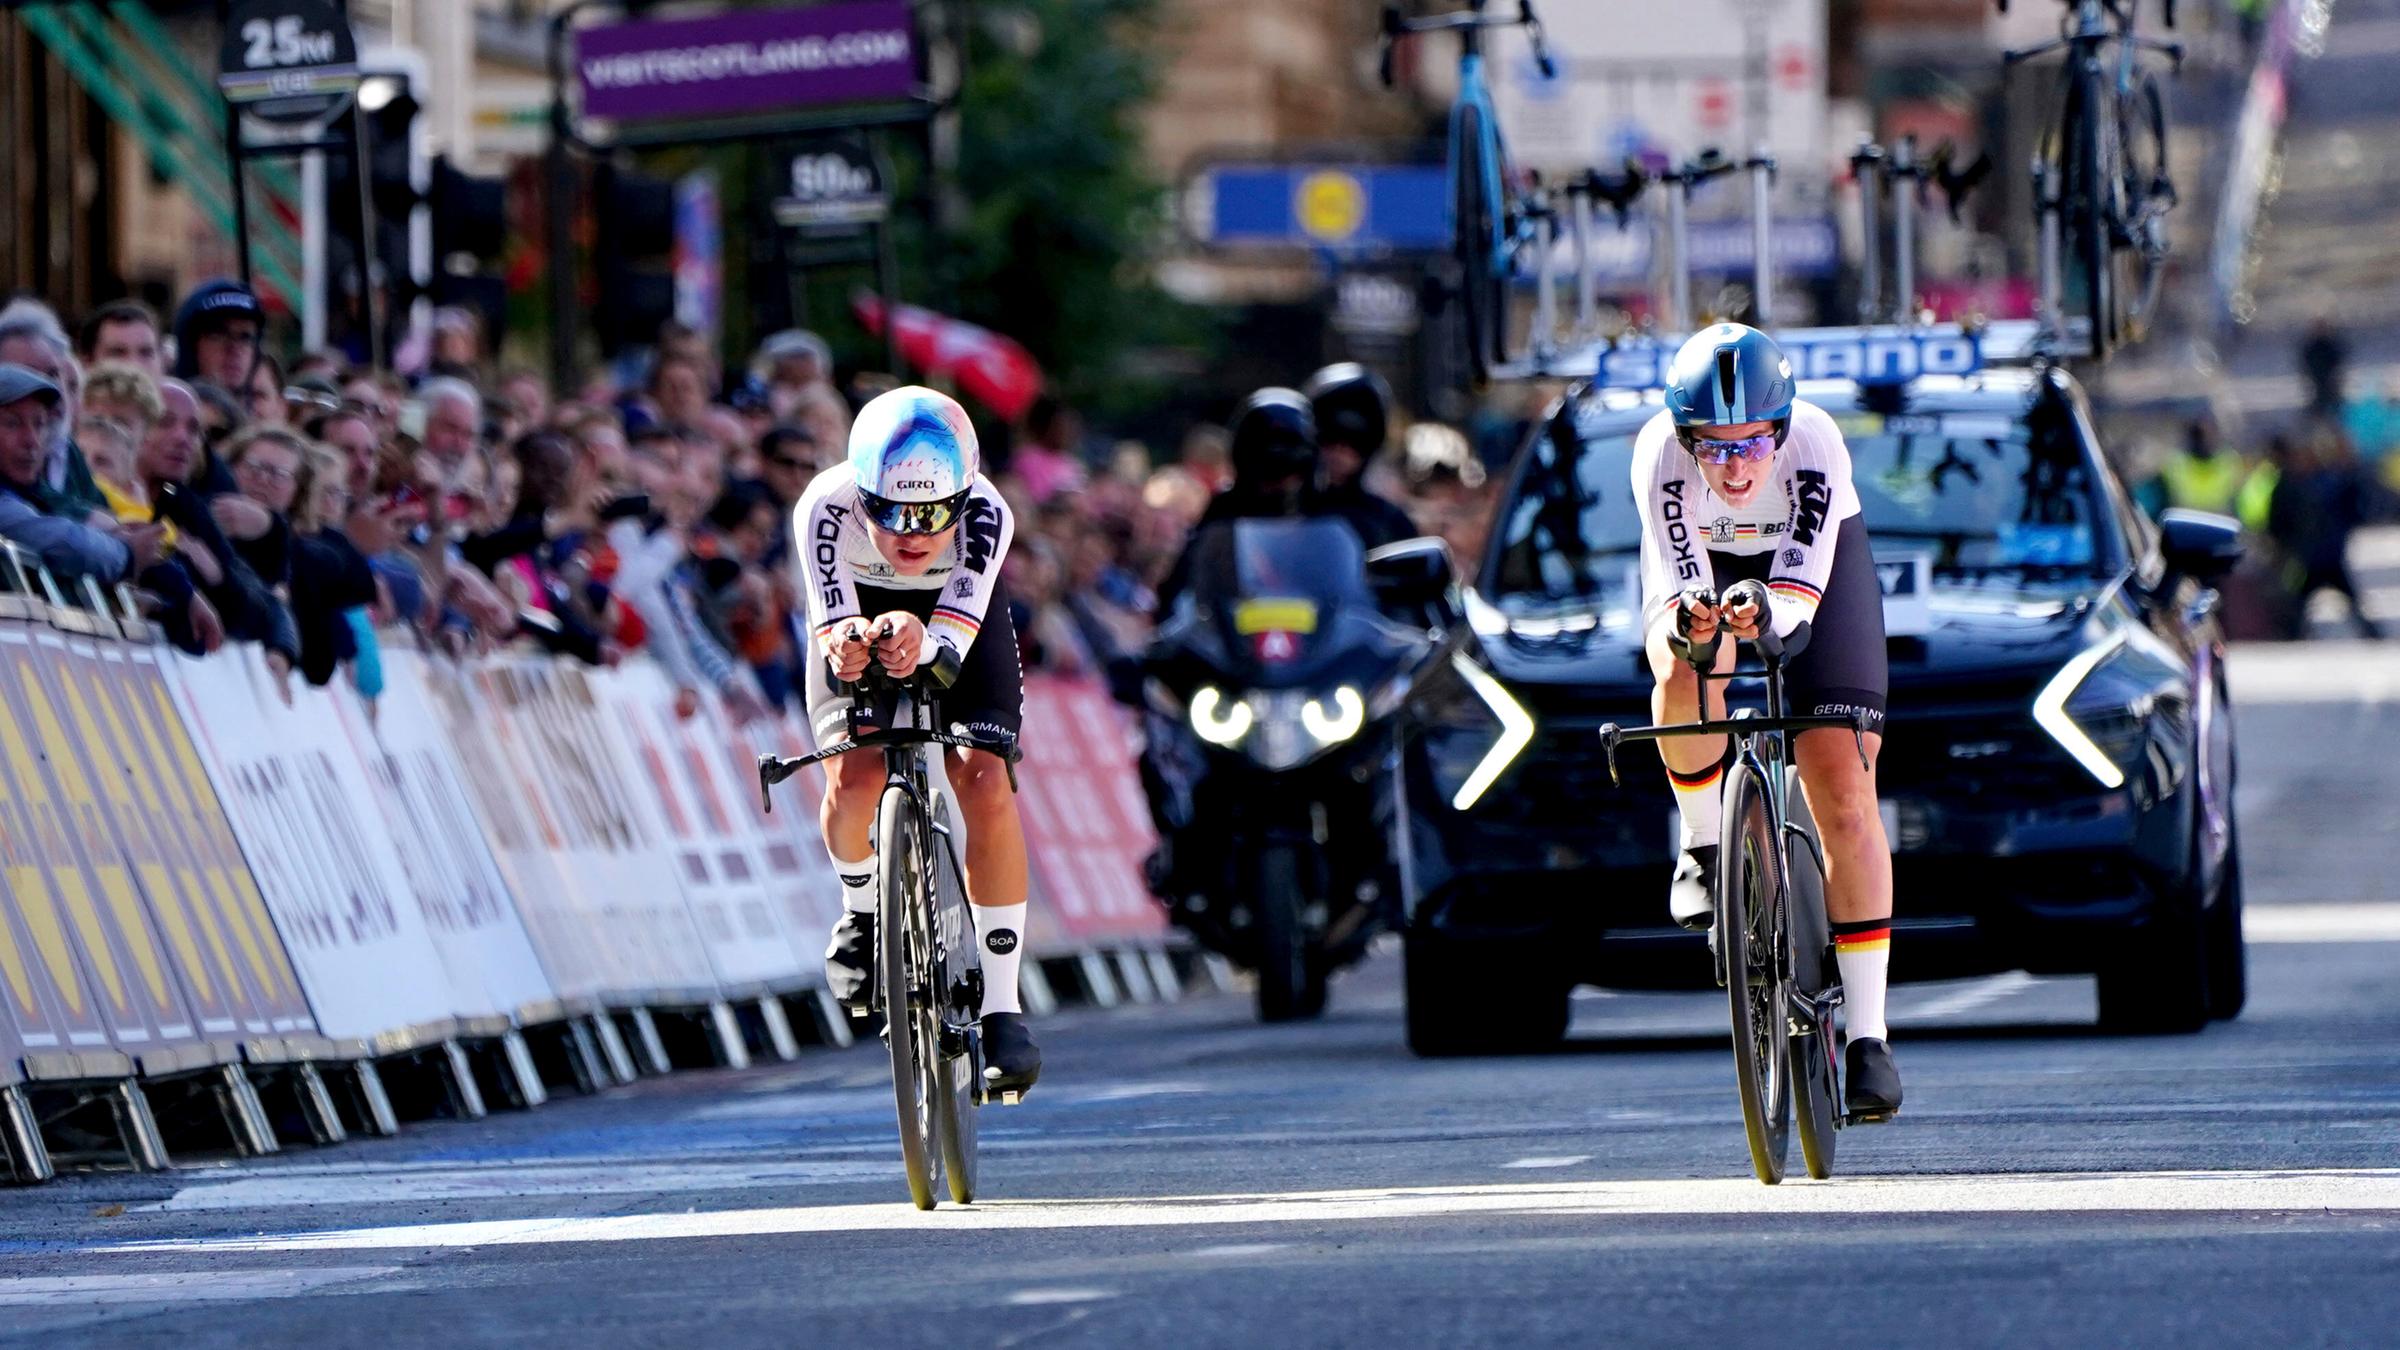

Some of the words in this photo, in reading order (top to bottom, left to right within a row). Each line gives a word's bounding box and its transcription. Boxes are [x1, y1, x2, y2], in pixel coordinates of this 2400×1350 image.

[896, 480, 935, 490] GIRO
[1793, 470, 1832, 547] KTM
[964, 497, 1003, 575] KTM
[931, 733, 973, 748] CANYON
[989, 936, 1015, 946] BOA
